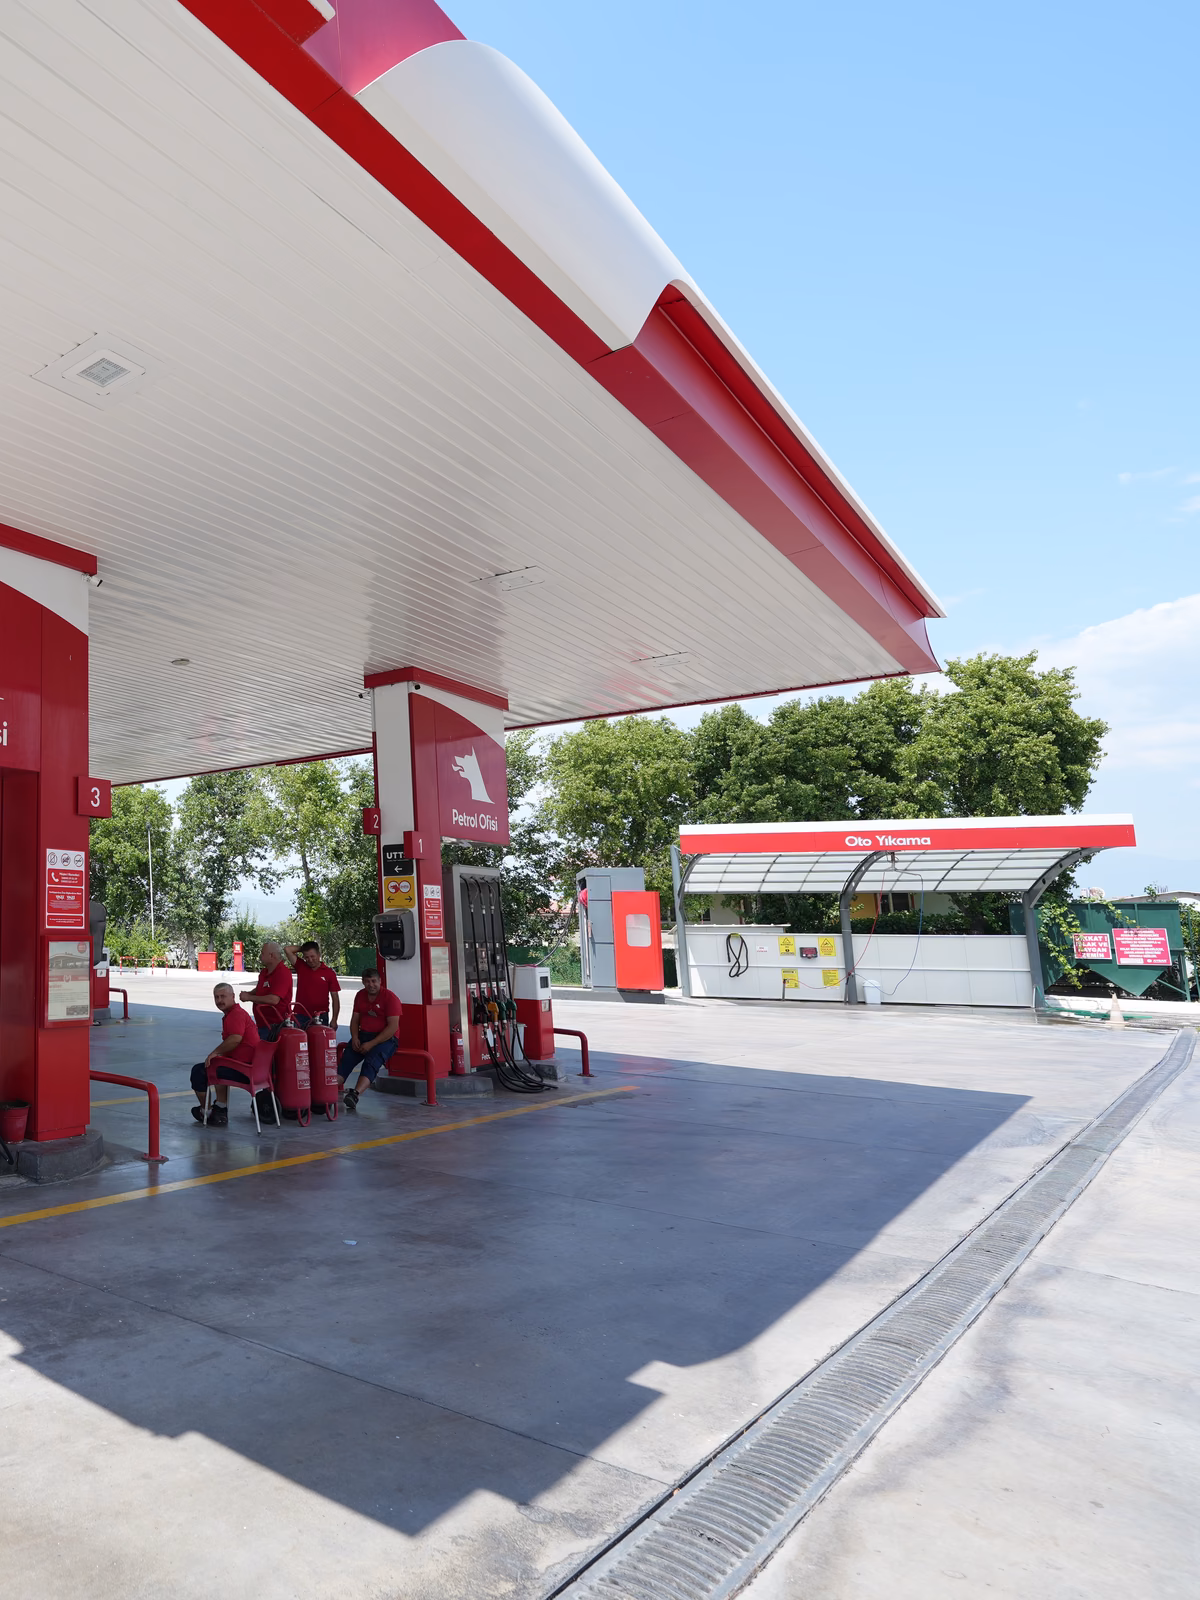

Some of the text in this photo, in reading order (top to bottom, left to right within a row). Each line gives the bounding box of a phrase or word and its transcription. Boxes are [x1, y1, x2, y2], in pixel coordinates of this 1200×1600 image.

[90, 786, 101, 808] 3
[373, 814, 379, 829] 2
[452, 808, 498, 832] Petrol Ofisi
[418, 838, 423, 853] 1
[844, 835, 931, 847] Oto Yıkama
[386, 851, 406, 860] UTT
